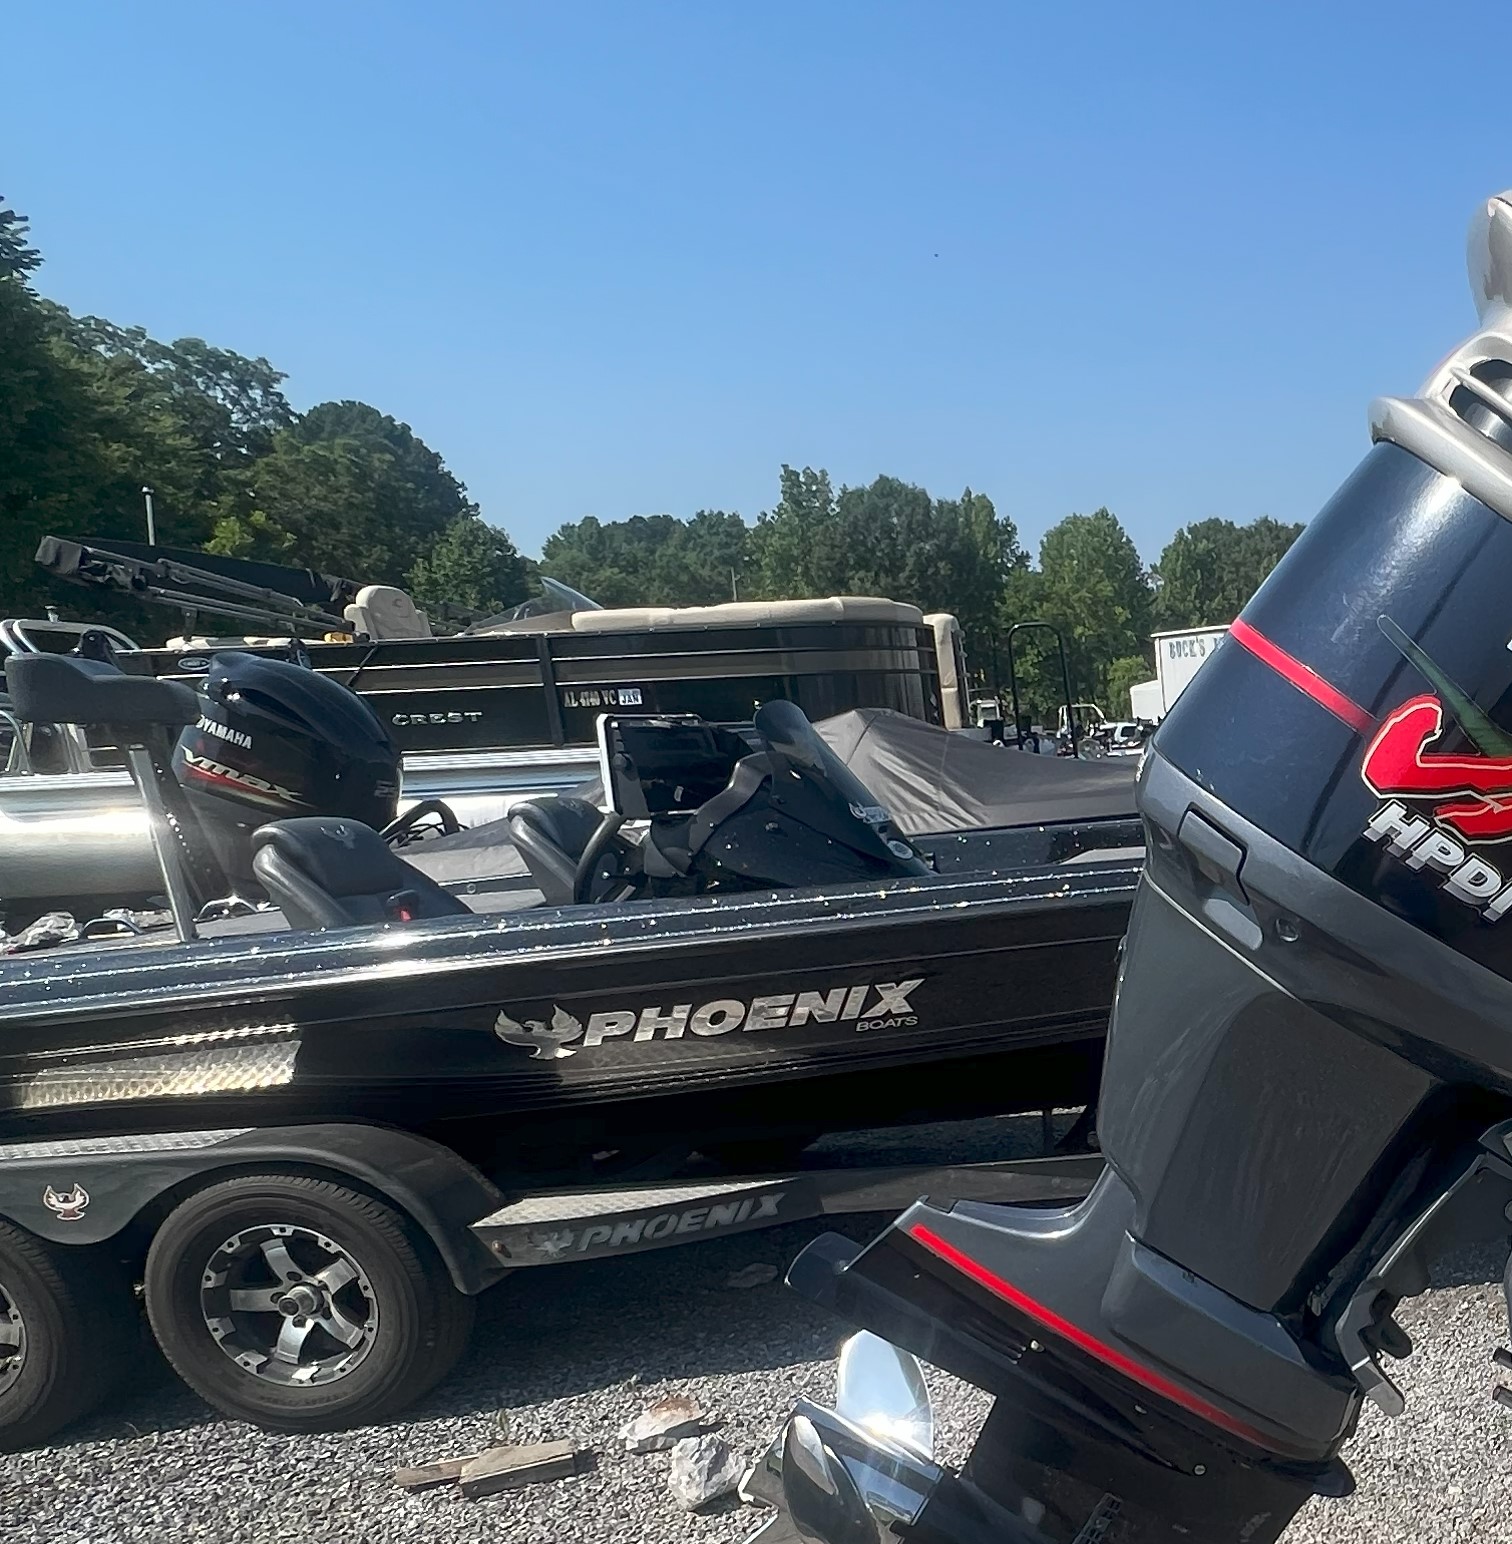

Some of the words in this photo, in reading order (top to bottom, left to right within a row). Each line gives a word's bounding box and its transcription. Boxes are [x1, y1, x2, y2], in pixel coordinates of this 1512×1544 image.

[1168, 636, 1206, 659] BUCK'S
[391, 711, 482, 726] CREST
[202, 717, 252, 749] YAMAHA
[583, 978, 926, 1047] PHOENIX
[855, 1015, 919, 1032] BOATS
[578, 1192, 786, 1251] PHOENIX
